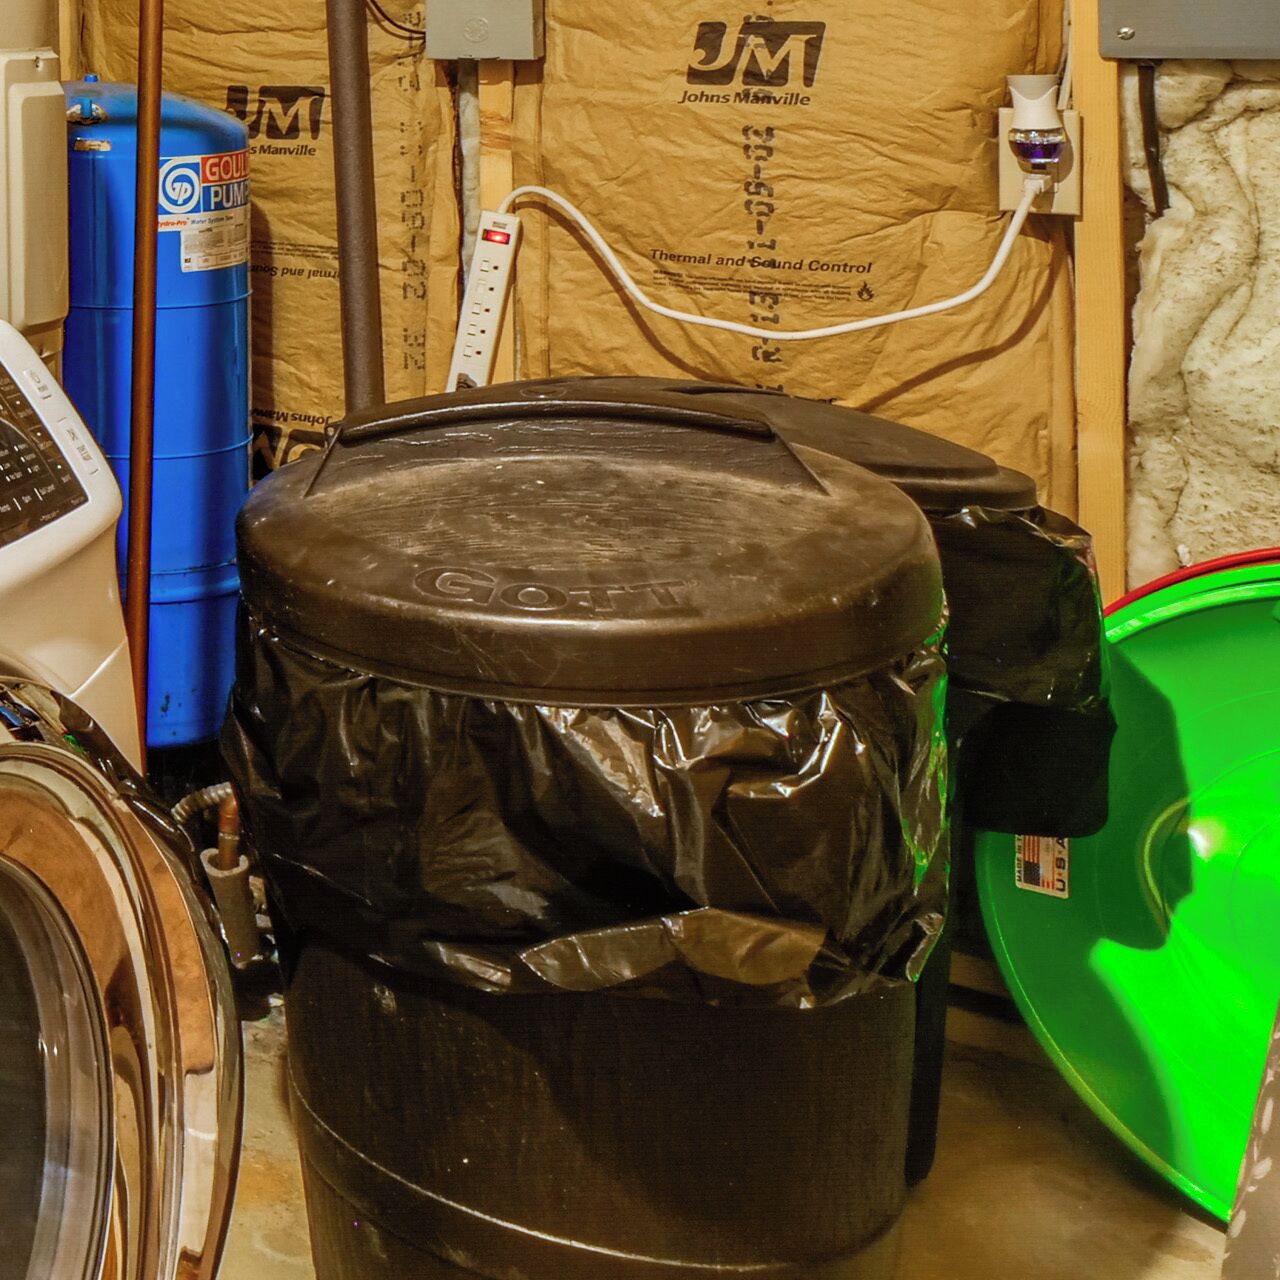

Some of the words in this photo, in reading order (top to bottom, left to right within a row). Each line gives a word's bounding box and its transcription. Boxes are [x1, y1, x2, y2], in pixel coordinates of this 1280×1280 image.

[677, 90, 730, 105] Johns
[733, 91, 812, 106] Manville
[258, 145, 316, 157] Manville
[206, 154, 249, 181] GOUL
[650, 248, 712, 266] Thermal
[715, 255, 747, 267] and
[750, 256, 804, 272] Sound
[807, 259, 874, 274] Control
[281, 267, 305, 277] and
[291, 412, 332, 427] Johns
[413, 566, 685, 611] GOTT
